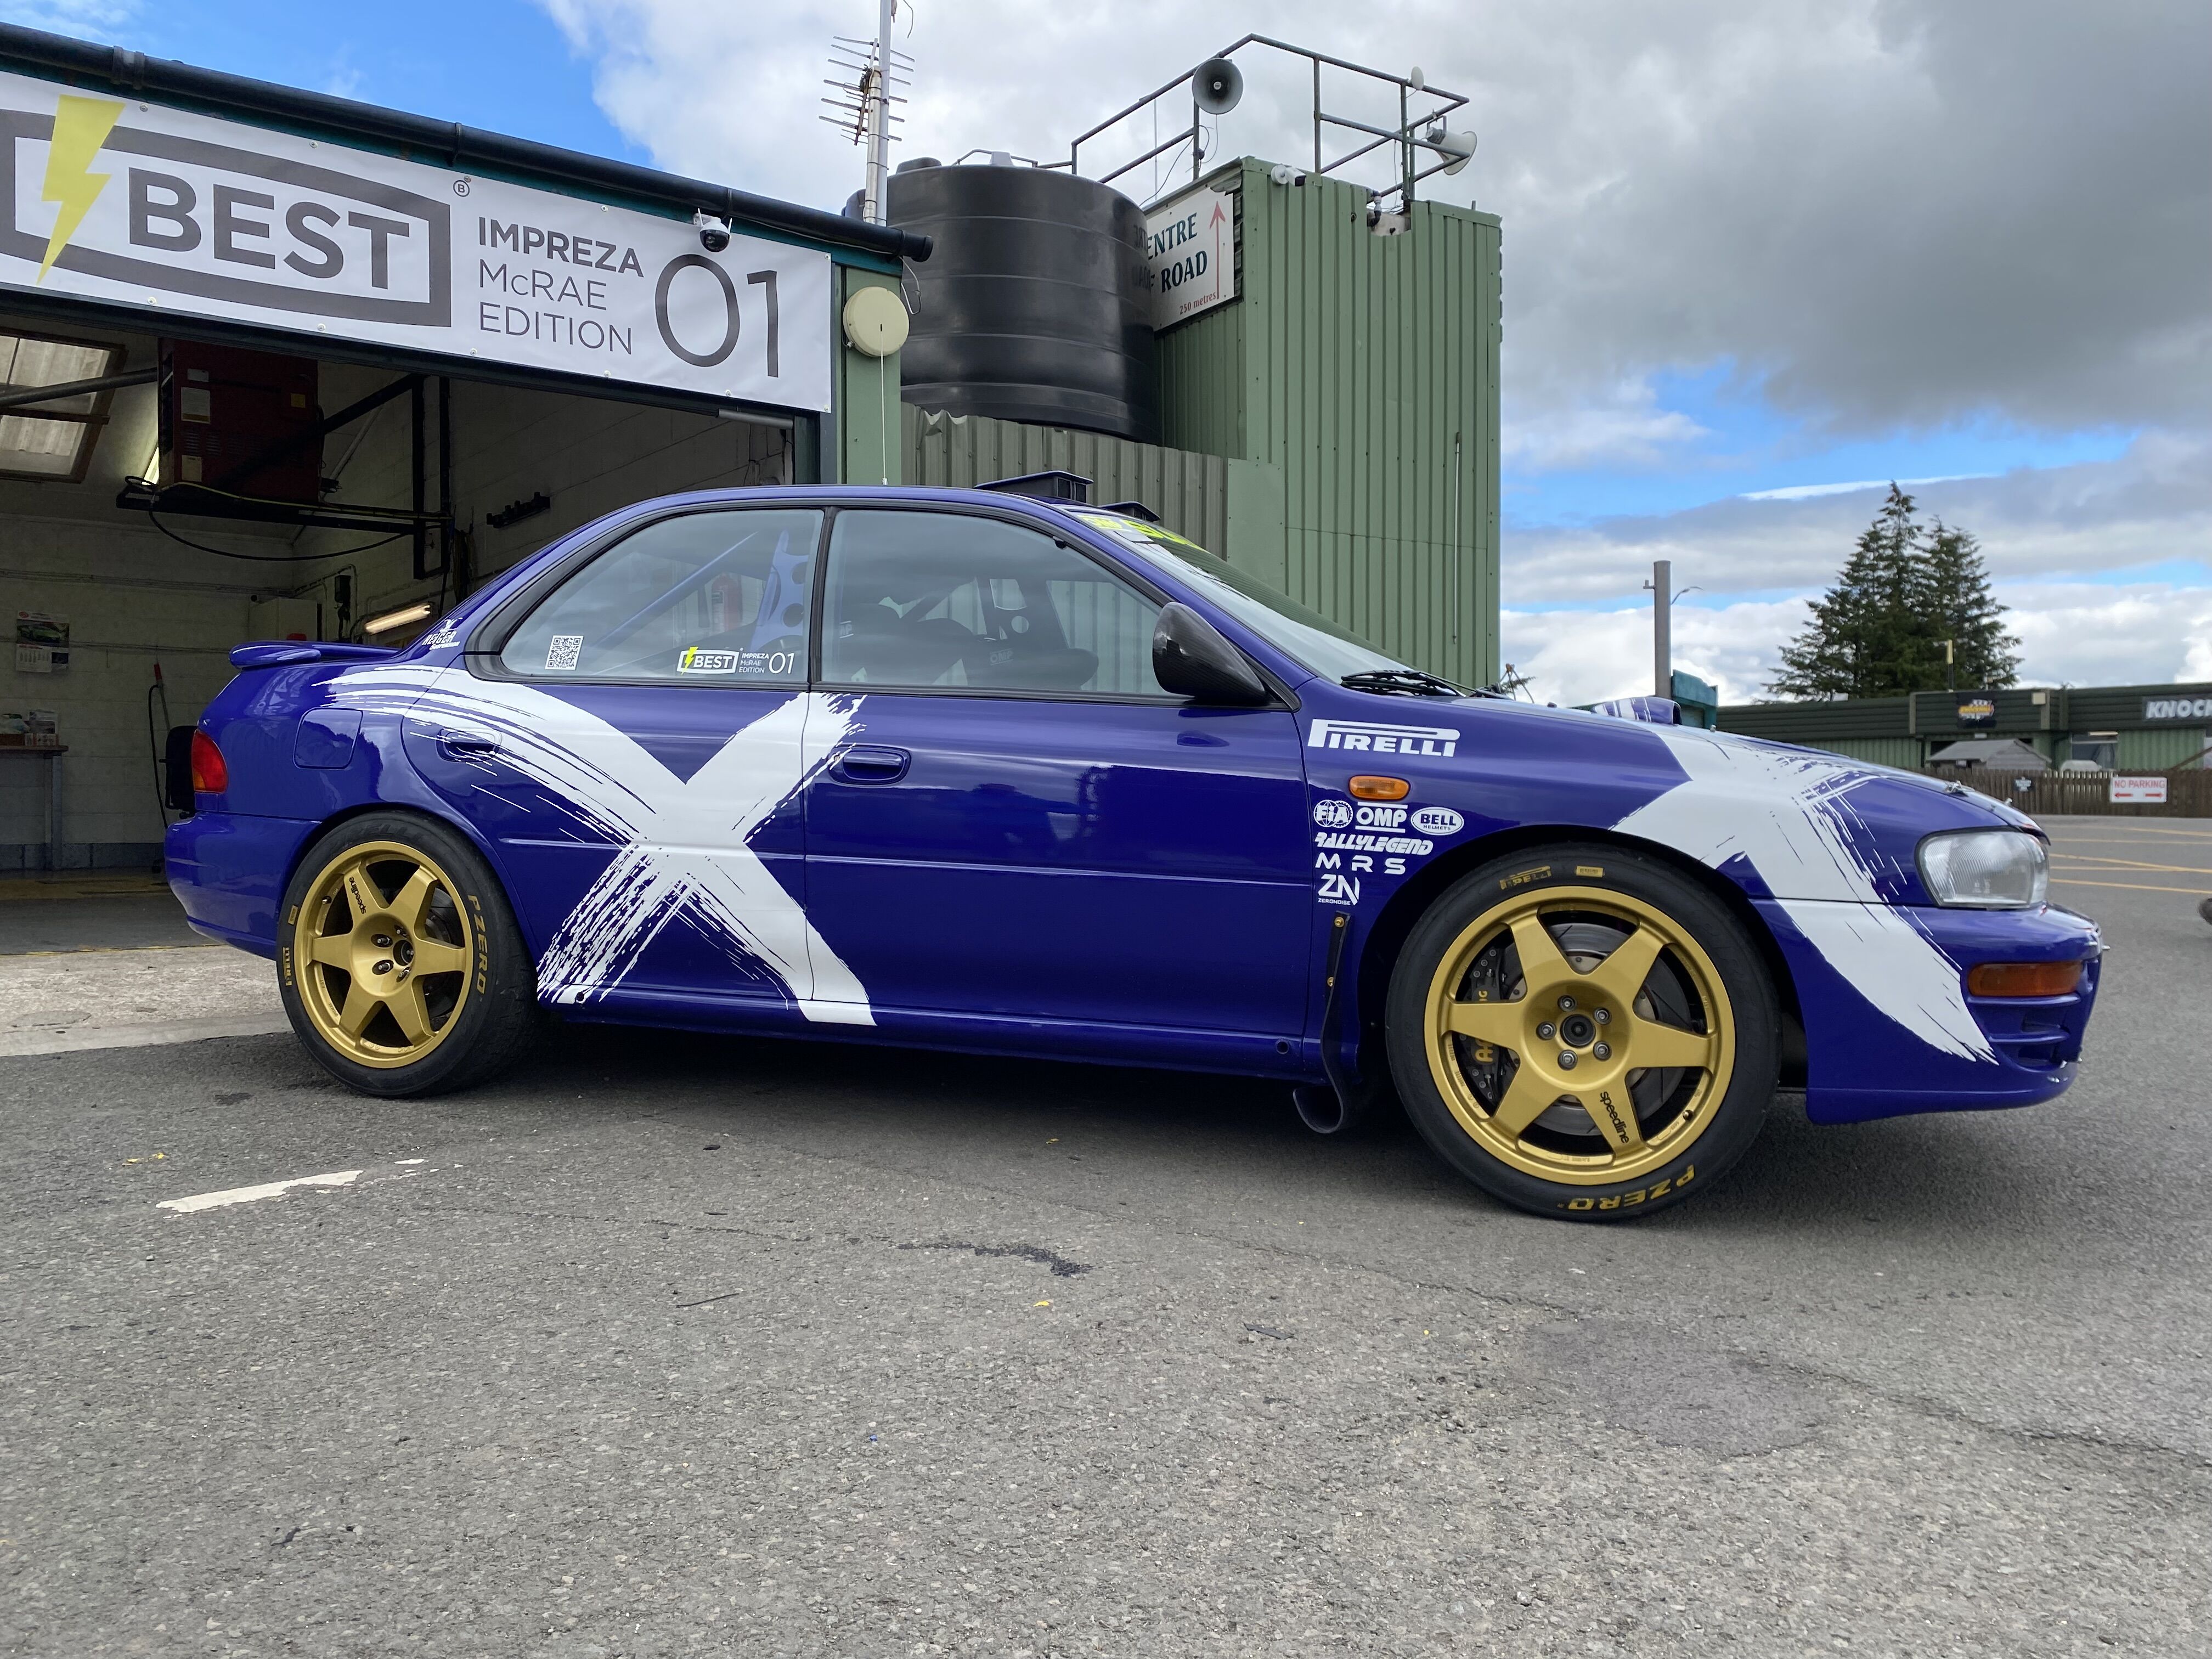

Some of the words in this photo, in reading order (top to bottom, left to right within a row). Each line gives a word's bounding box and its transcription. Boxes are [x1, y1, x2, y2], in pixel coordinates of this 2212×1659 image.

[128, 167, 410, 290] BEST
[479, 217, 644, 278] IMPREZA
[1148, 212, 1198, 260] ENTRE
[1161, 250, 1207, 293] ROAD
[655, 254, 778, 378] 01
[1180, 303, 1192, 315] 250
[1193, 291, 1216, 309] metres
[479, 302, 631, 354] EDITION
[693, 656, 732, 668] BEST
[769, 652, 794, 674] 01
[1307, 719, 1460, 757] PIRELLI
[2129, 780, 2165, 788] PARKING
[1356, 807, 1407, 827] OMP
[1420, 814, 1457, 826] BELL
[1314, 832, 1434, 855] RALLYLEGEND
[349, 877, 366, 915] speedline
[1318, 874, 1360, 906] ZN
[1600, 1091, 1629, 1144] speedline
